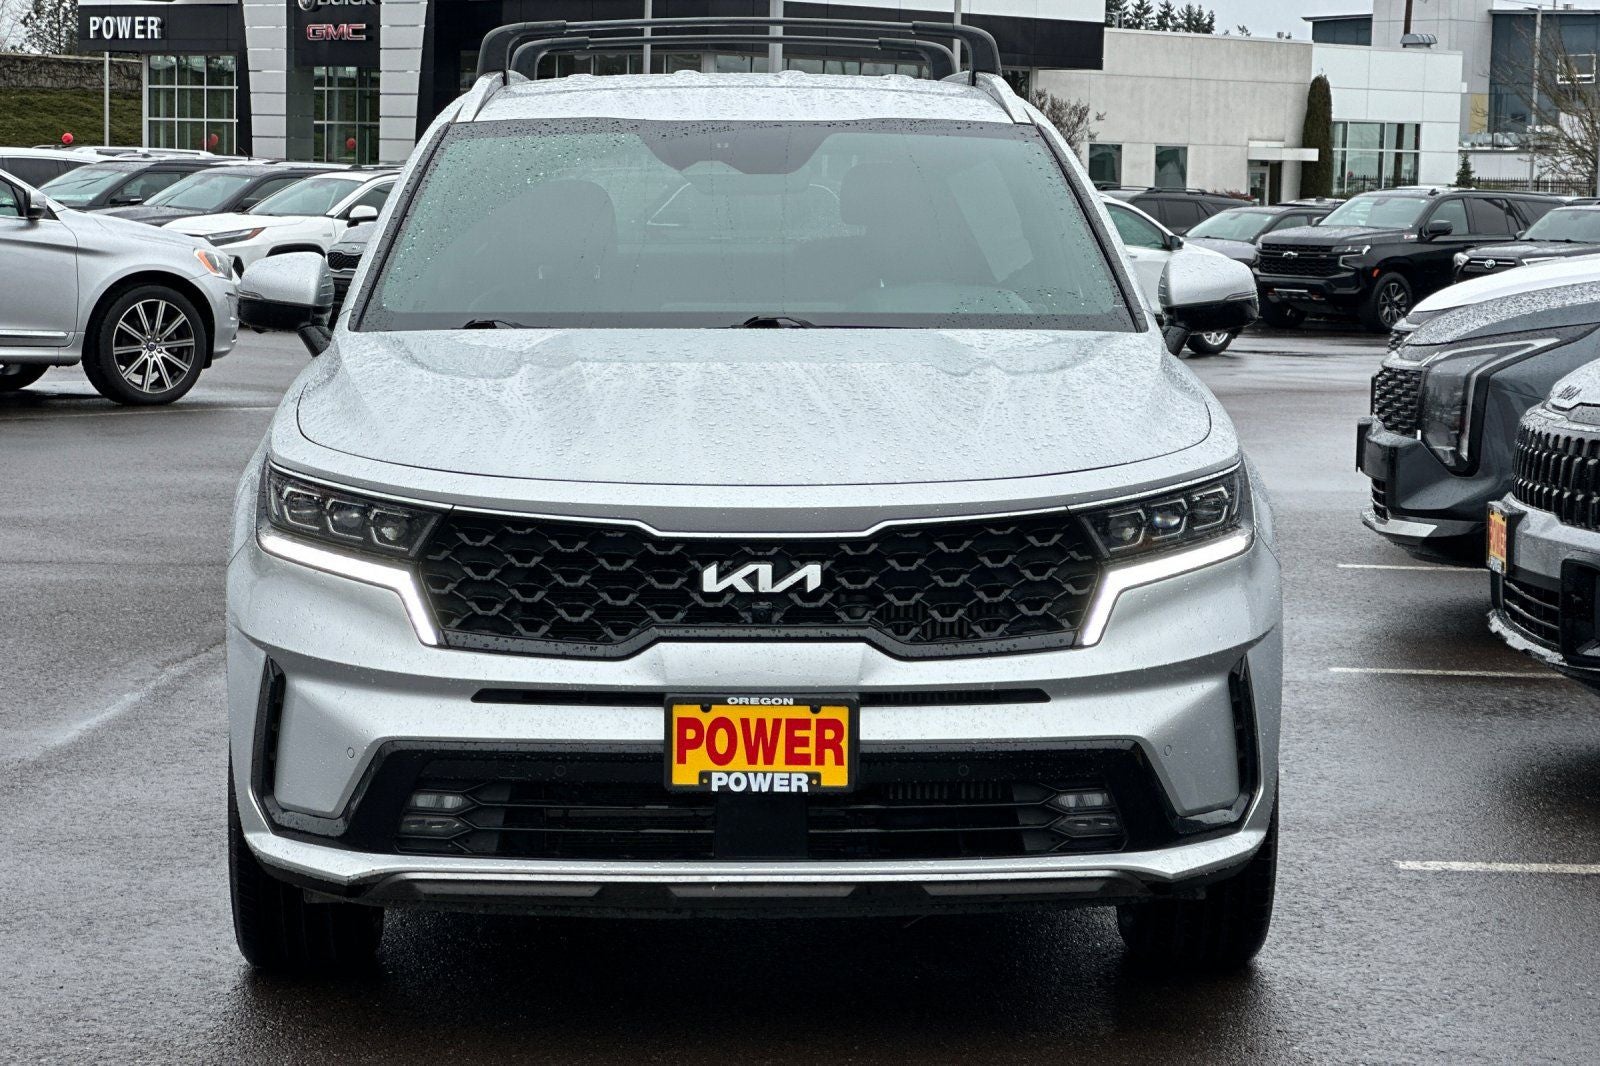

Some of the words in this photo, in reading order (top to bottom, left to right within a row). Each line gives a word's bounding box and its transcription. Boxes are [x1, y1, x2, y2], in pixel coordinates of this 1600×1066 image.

[89, 16, 161, 39] POWER
[306, 23, 366, 40] GMC
[702, 561, 821, 593] KIA
[726, 697, 794, 706] OREGON
[676, 716, 845, 766] POWER
[711, 772, 809, 793] POWER
